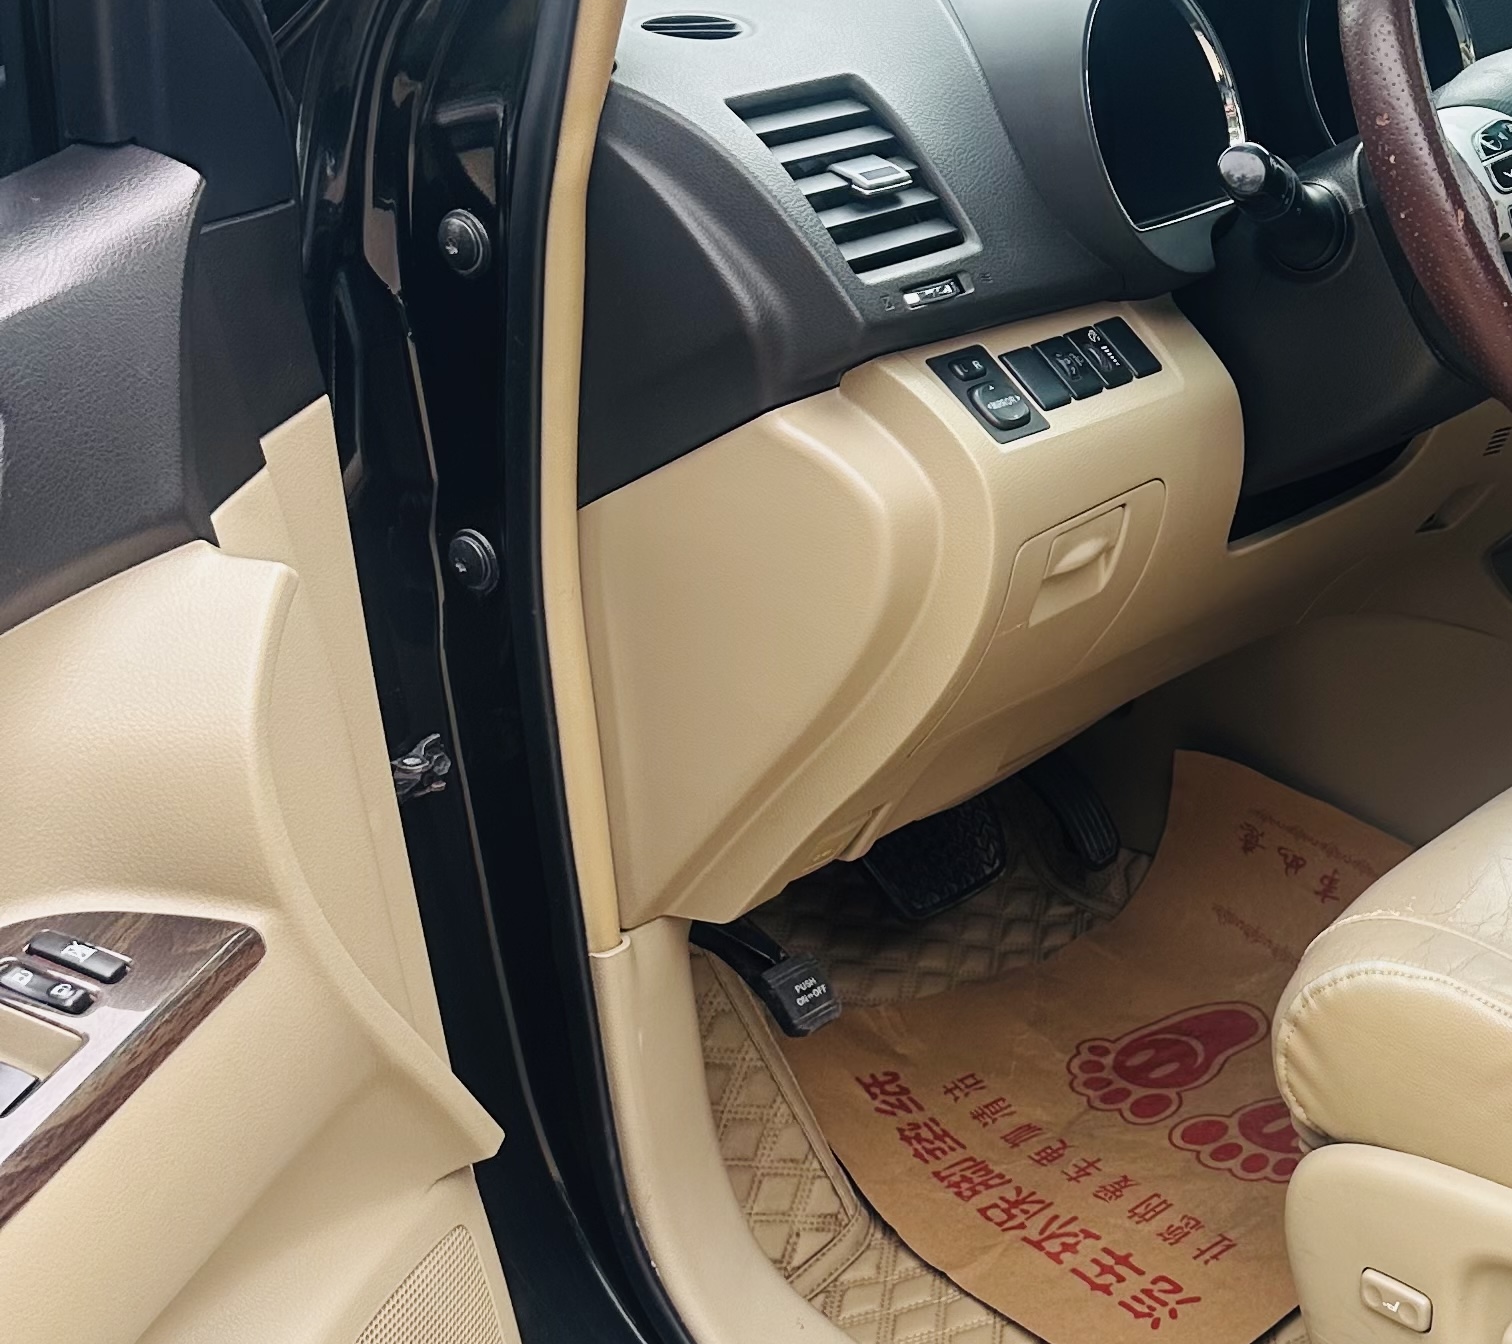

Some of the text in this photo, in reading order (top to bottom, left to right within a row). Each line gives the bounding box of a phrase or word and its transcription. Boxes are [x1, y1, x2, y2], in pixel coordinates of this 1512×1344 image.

[971, 359, 983, 370] R
[794, 976, 818, 994] PUSH
[854, 1069, 1202, 1331] 汽车环保脚垫纸
[942, 1072, 1238, 1265] 让您的爱车更加清洁
